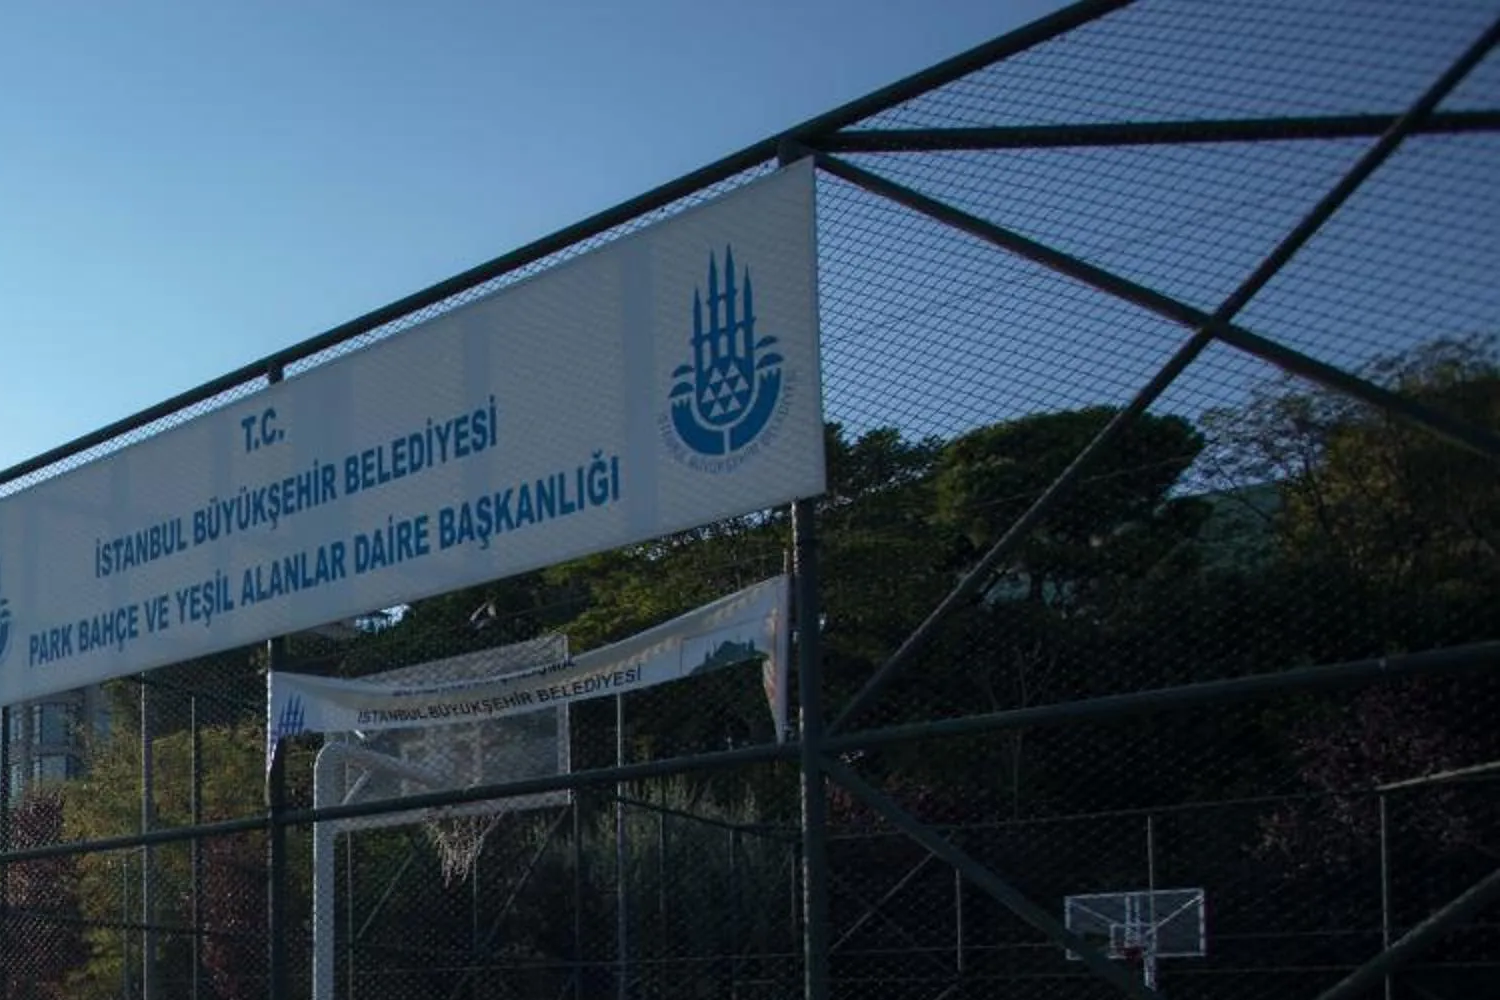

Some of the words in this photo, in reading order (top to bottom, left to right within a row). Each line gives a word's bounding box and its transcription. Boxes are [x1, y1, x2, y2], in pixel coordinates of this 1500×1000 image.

[94, 517, 188, 579] İSTANBUL
[192, 459, 337, 546] BÜYÜKŞEHİR
[344, 395, 498, 494] BELEDİYESİ
[241, 407, 285, 455] T.C.
[29, 623, 74, 668] PARK
[77, 604, 140, 653] BAHÇE
[144, 592, 171, 634] VE
[175, 568, 235, 626] YEŞİL
[240, 541, 347, 605] ALANLAR
[353, 514, 430, 574] DAİRE
[438, 449, 621, 550] BAŞKANLIĞI
